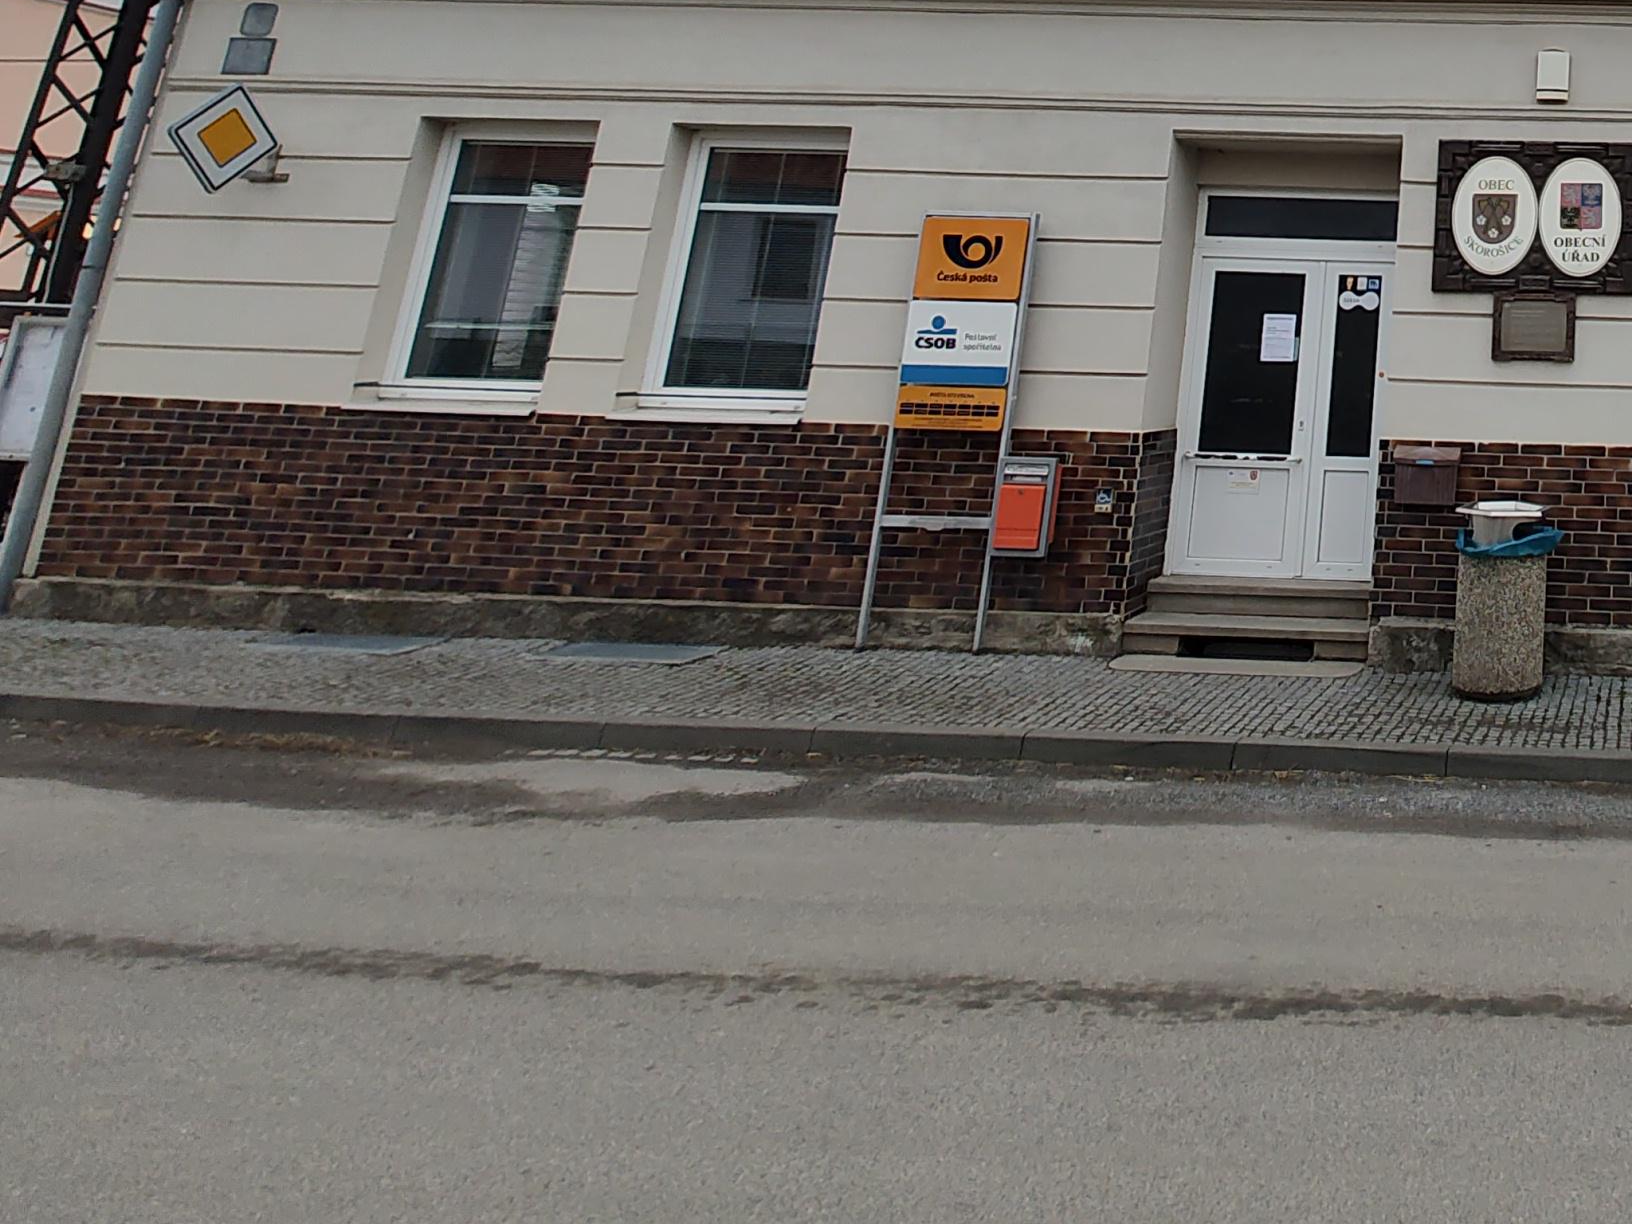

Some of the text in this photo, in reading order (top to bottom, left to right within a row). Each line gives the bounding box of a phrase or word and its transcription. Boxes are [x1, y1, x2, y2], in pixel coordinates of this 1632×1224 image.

[1478, 179, 1515, 192] OBEC
[1553, 233, 1606, 249] OBECNÍ
[1561, 249, 1601, 264] ÚŘAD
[937, 270, 967, 282] Česká
